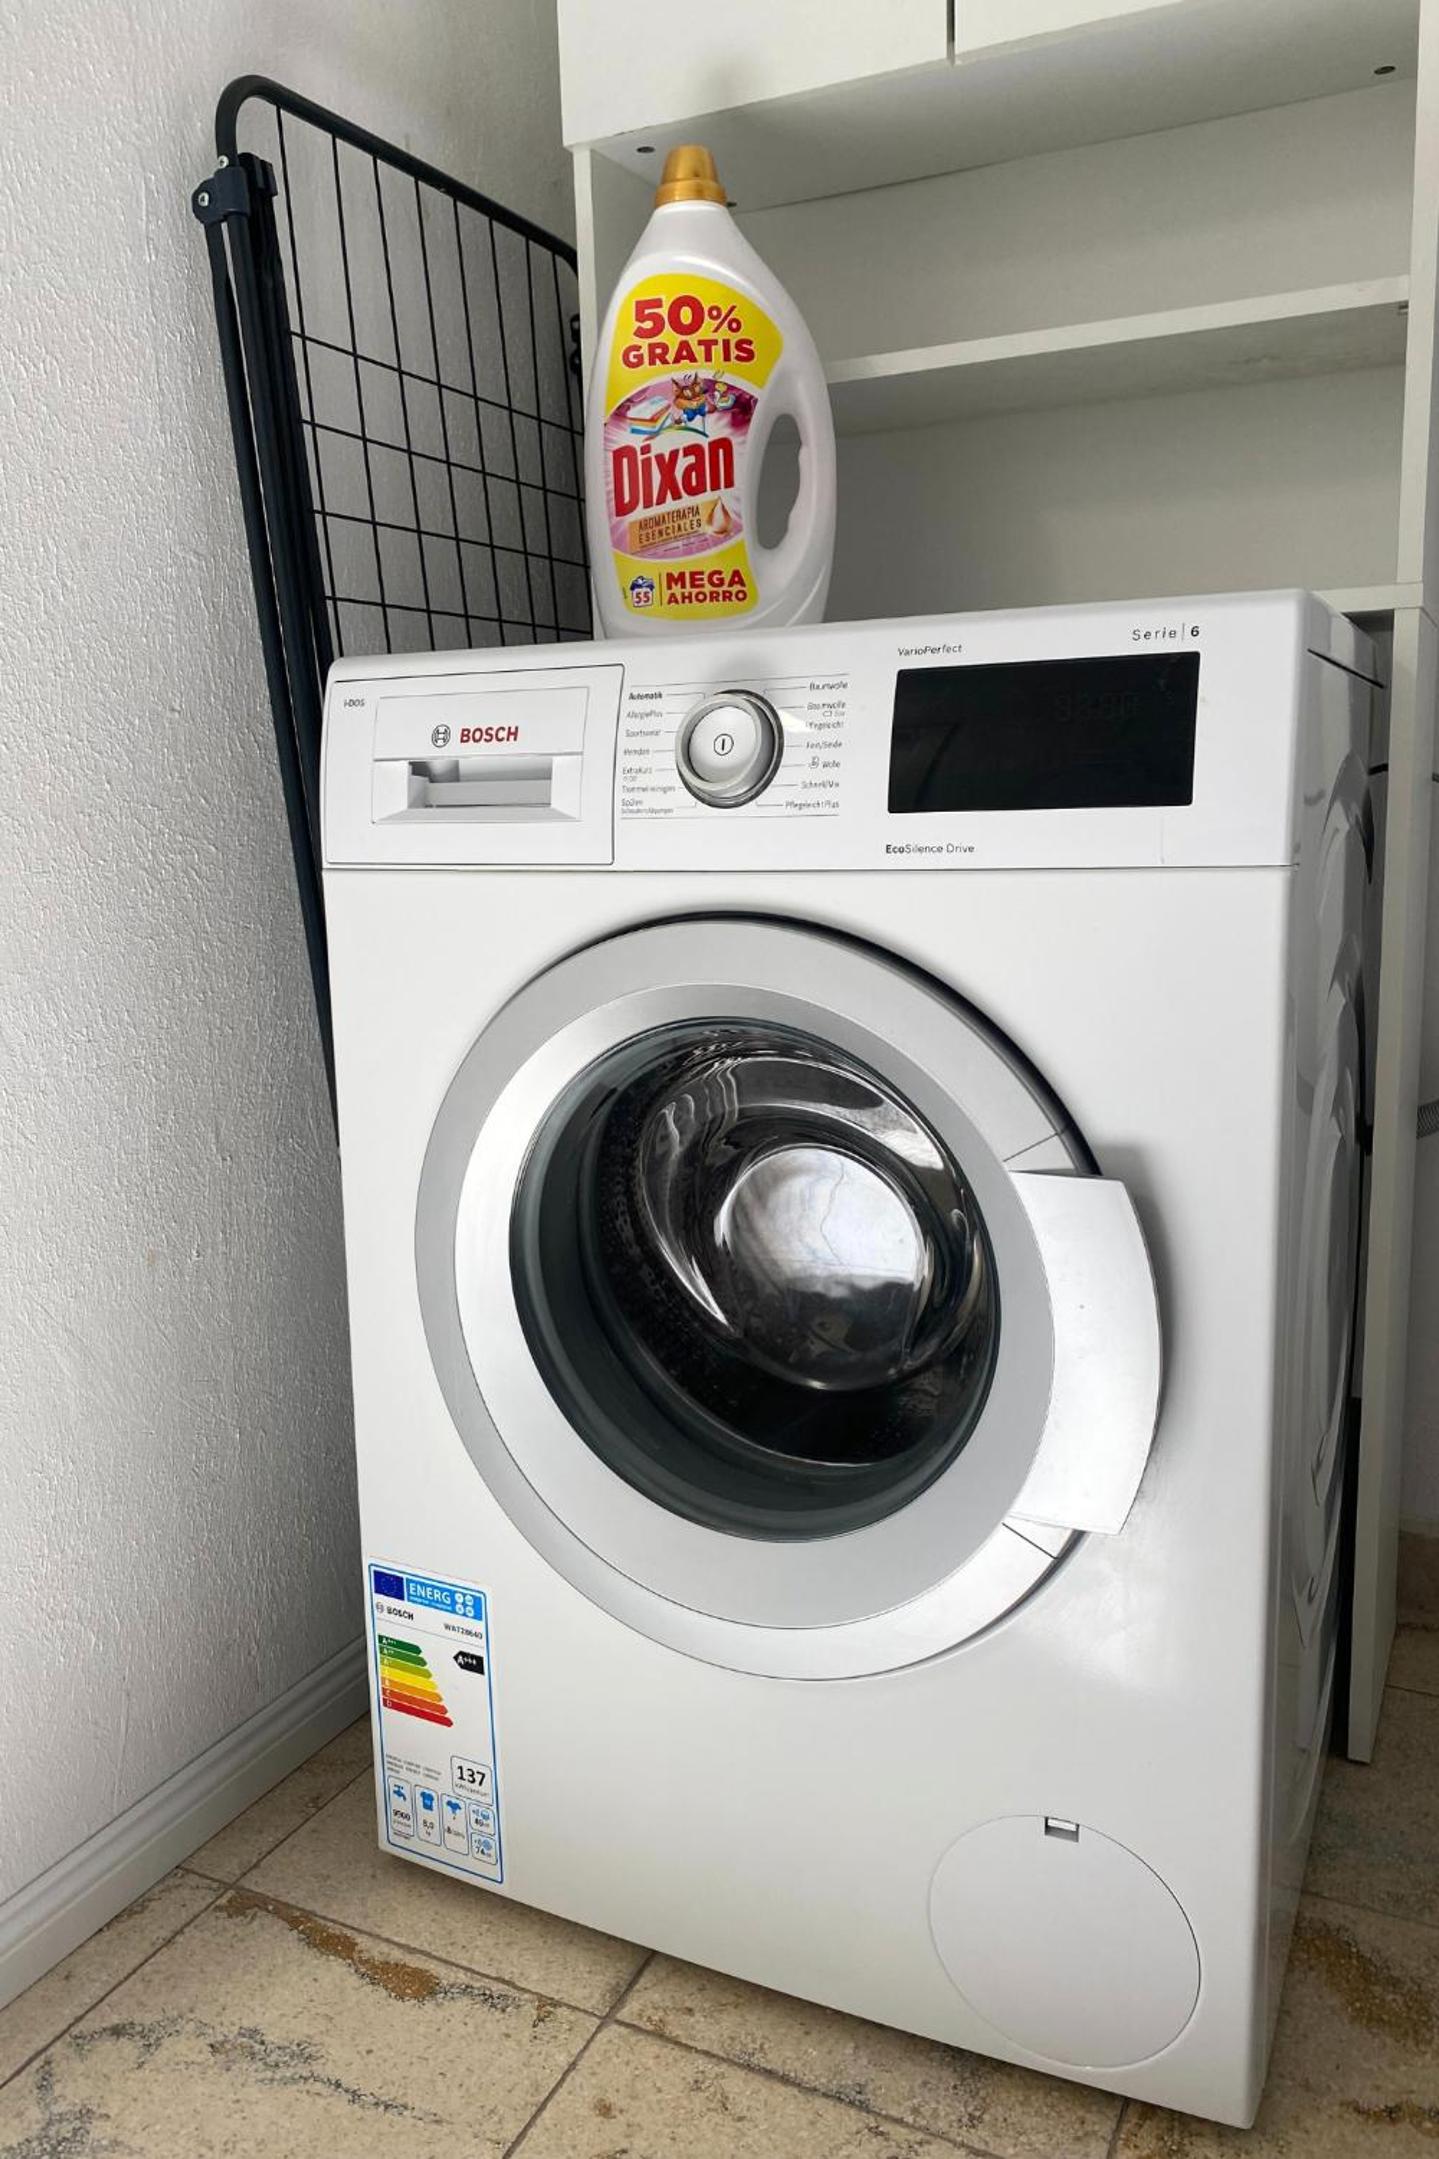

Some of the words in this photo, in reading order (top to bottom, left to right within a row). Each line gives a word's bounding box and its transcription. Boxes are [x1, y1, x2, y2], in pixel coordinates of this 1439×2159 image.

[632, 294, 742, 340] 50%
[621, 338, 756, 369] GRATIS
[612, 435, 735, 518] Dixan
[638, 504, 701, 530] AROMATERAPIA
[638, 519, 703, 544] ESENCIALES
[634, 589, 651, 605] 55
[665, 568, 747, 590] MEGA
[666, 589, 748, 605] AHORRO
[1131, 627, 1177, 641] Serie
[1190, 625, 1200, 638] 6
[897, 643, 962, 656] VarioPerfect
[459, 726, 518, 744] BOSCH
[885, 844, 944, 855] EcoSilence
[946, 843, 975, 854] Drive
[409, 1582, 452, 1605] ENERG
[386, 1606, 415, 1621] BOSCH
[456, 1765, 487, 1787] 137
